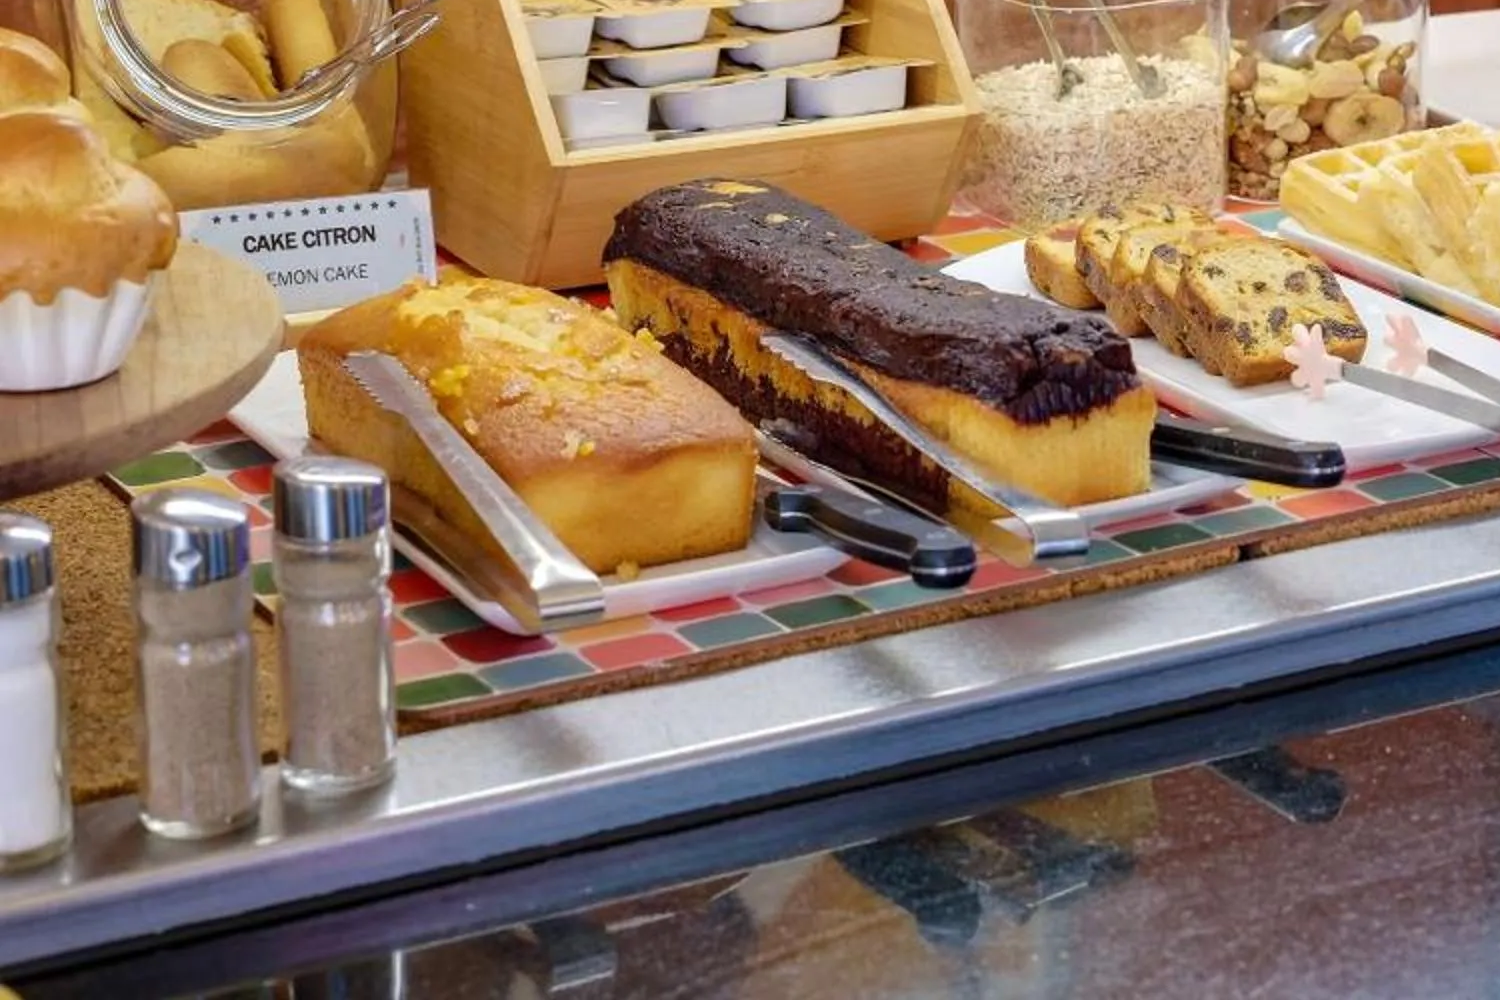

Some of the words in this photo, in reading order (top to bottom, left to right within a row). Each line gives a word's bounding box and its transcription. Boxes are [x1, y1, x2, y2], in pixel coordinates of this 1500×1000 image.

[242, 231, 299, 254] CAKE
[301, 224, 377, 249] CITRON
[265, 269, 320, 288] EMON
[322, 263, 370, 283] CAKE
